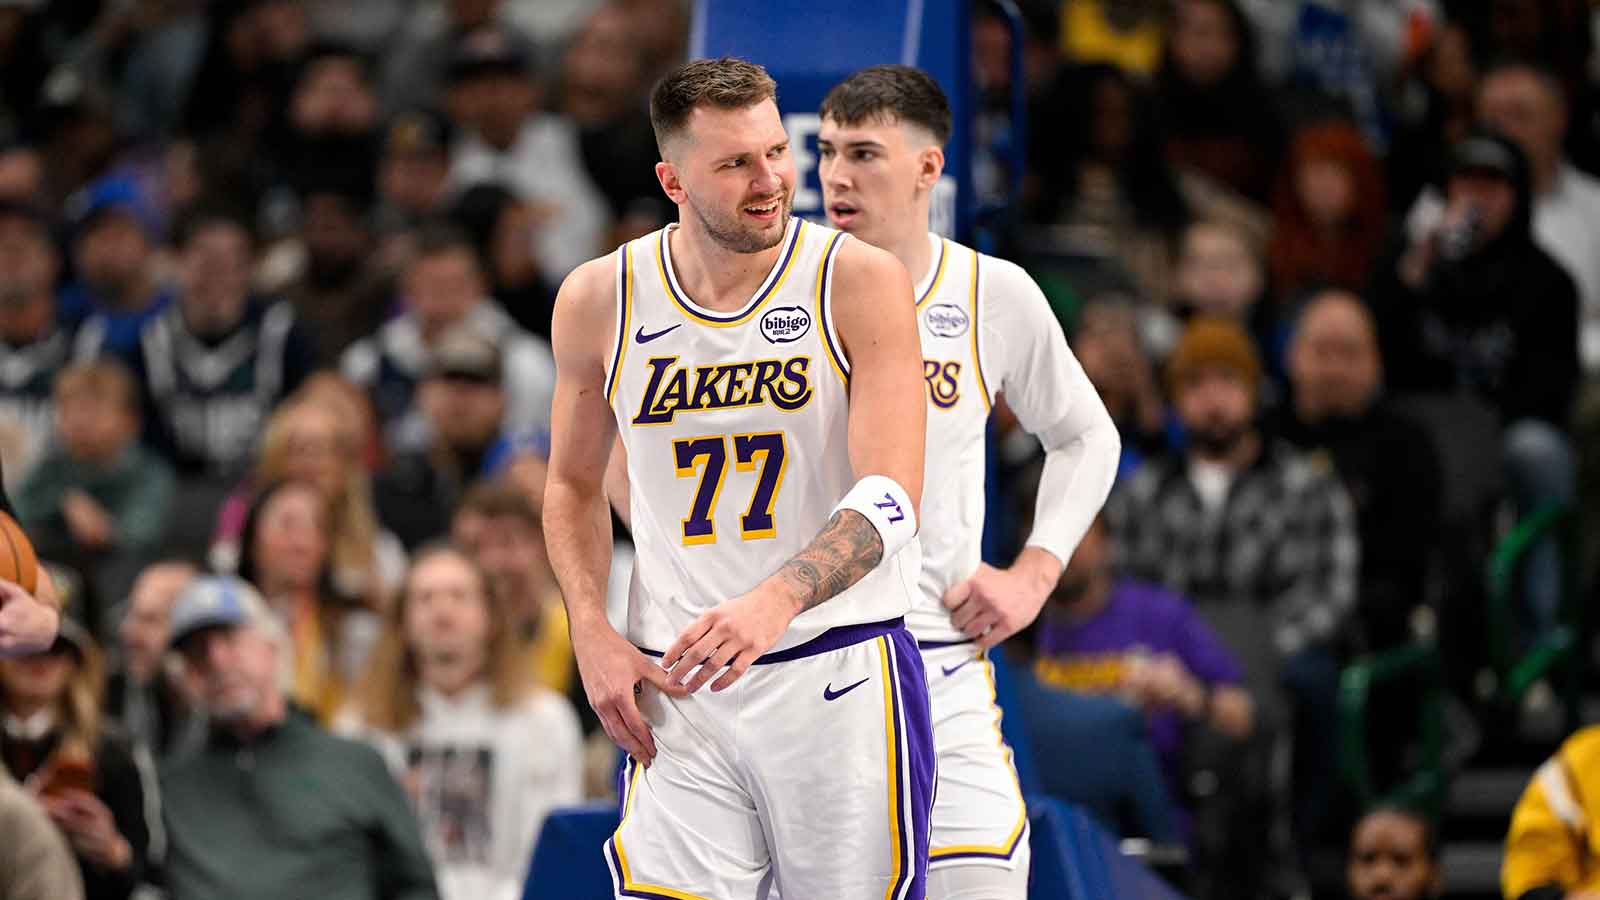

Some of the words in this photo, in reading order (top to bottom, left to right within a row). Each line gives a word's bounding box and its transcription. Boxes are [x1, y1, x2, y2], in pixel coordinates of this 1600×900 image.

[765, 316, 808, 331] bibigo
[632, 356, 815, 426] LAKERS
[672, 432, 789, 545] 77
[873, 492, 905, 526] 77
